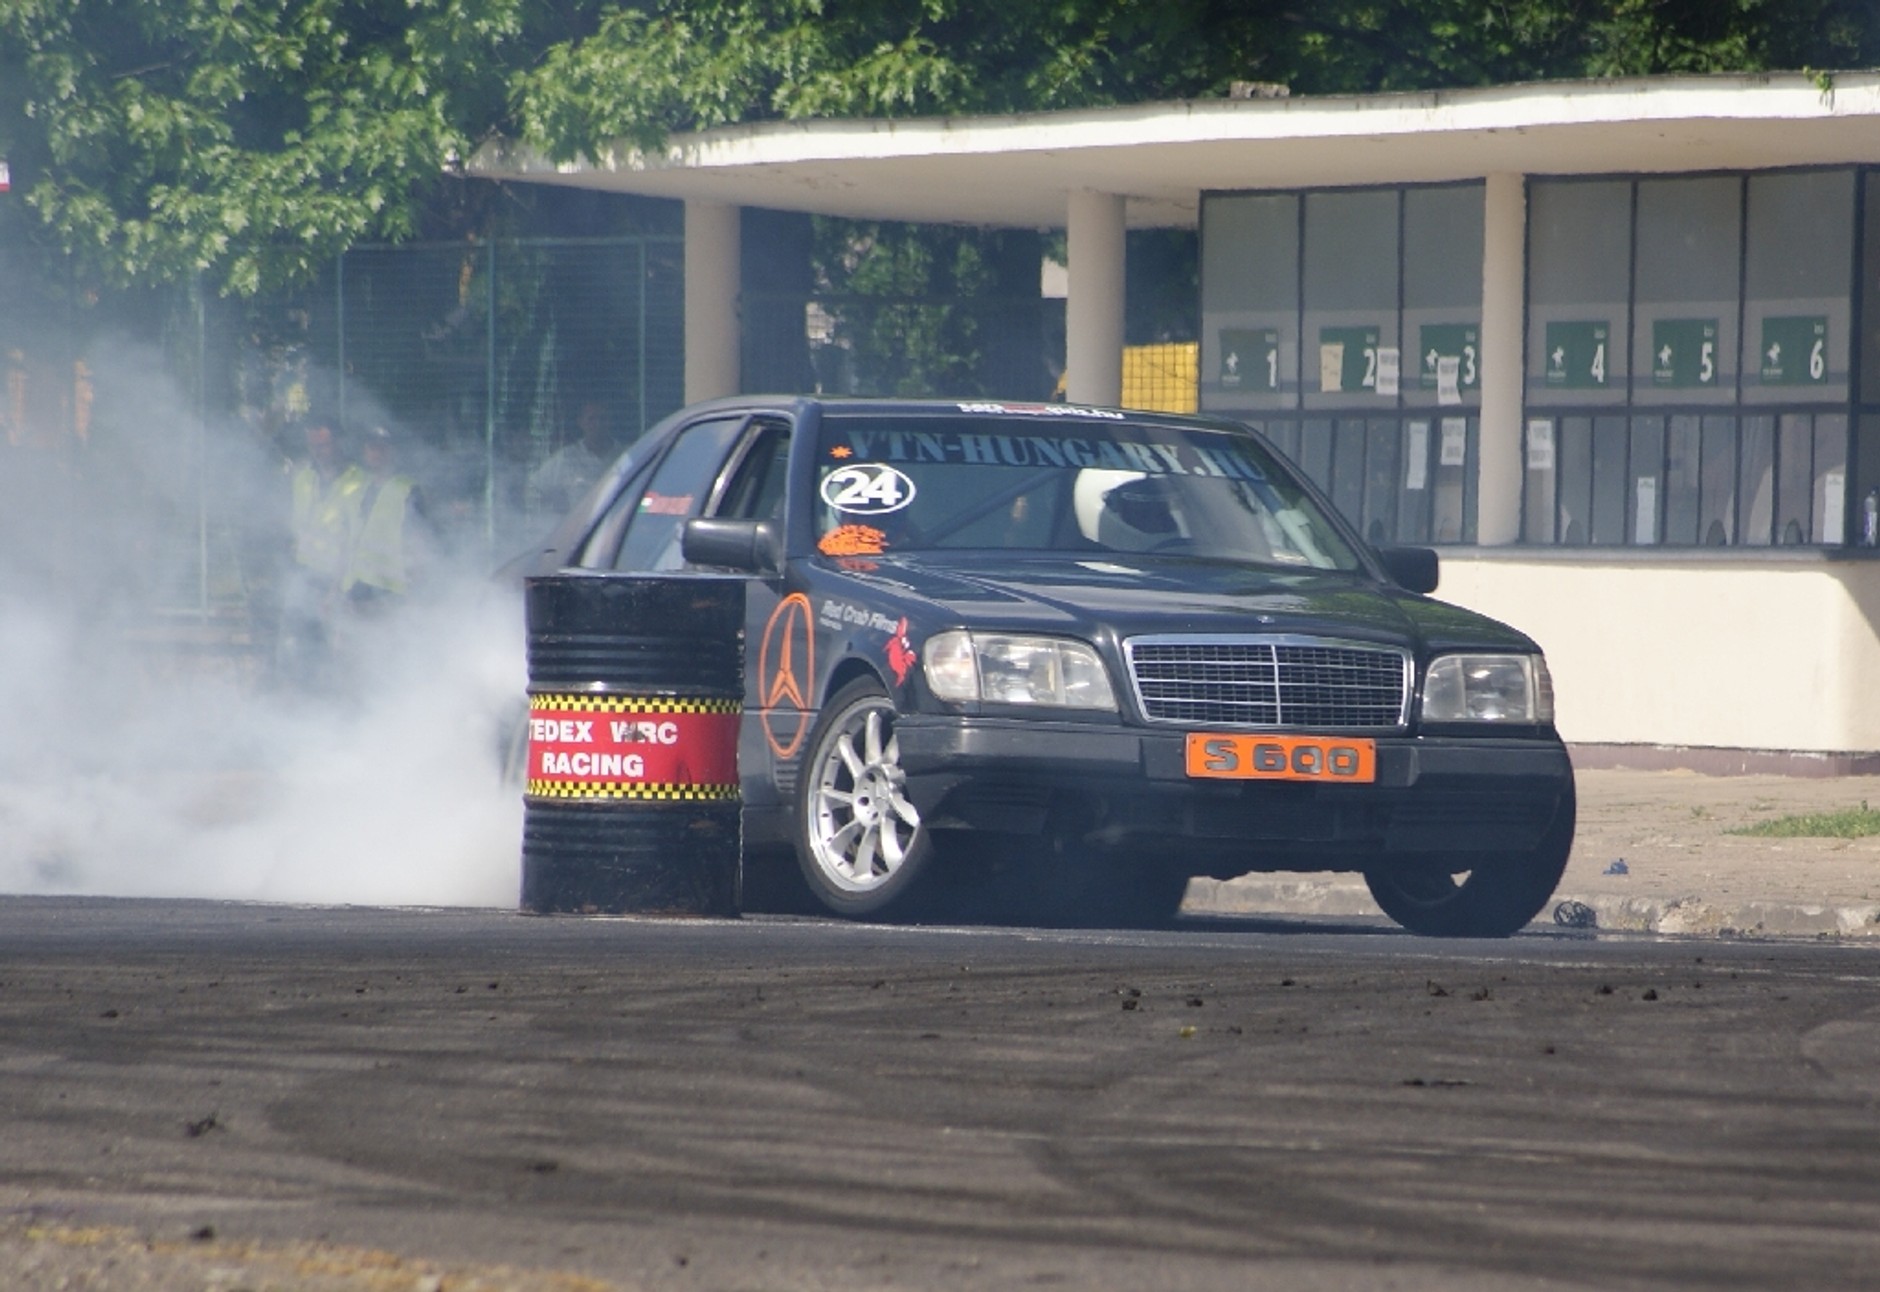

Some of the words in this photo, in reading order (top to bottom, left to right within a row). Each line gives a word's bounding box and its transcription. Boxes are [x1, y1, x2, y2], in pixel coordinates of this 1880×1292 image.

[1267, 349, 1277, 387] 1
[1361, 348, 1376, 387] 2
[1463, 345, 1476, 385] 3
[1591, 343, 1604, 383] 4
[1700, 341, 1713, 382] 5
[1810, 339, 1824, 380] 6
[832, 469, 902, 506] 24
[542, 752, 644, 778] RACING
[1204, 739, 1239, 771] S
[1252, 743, 1359, 777] 600
